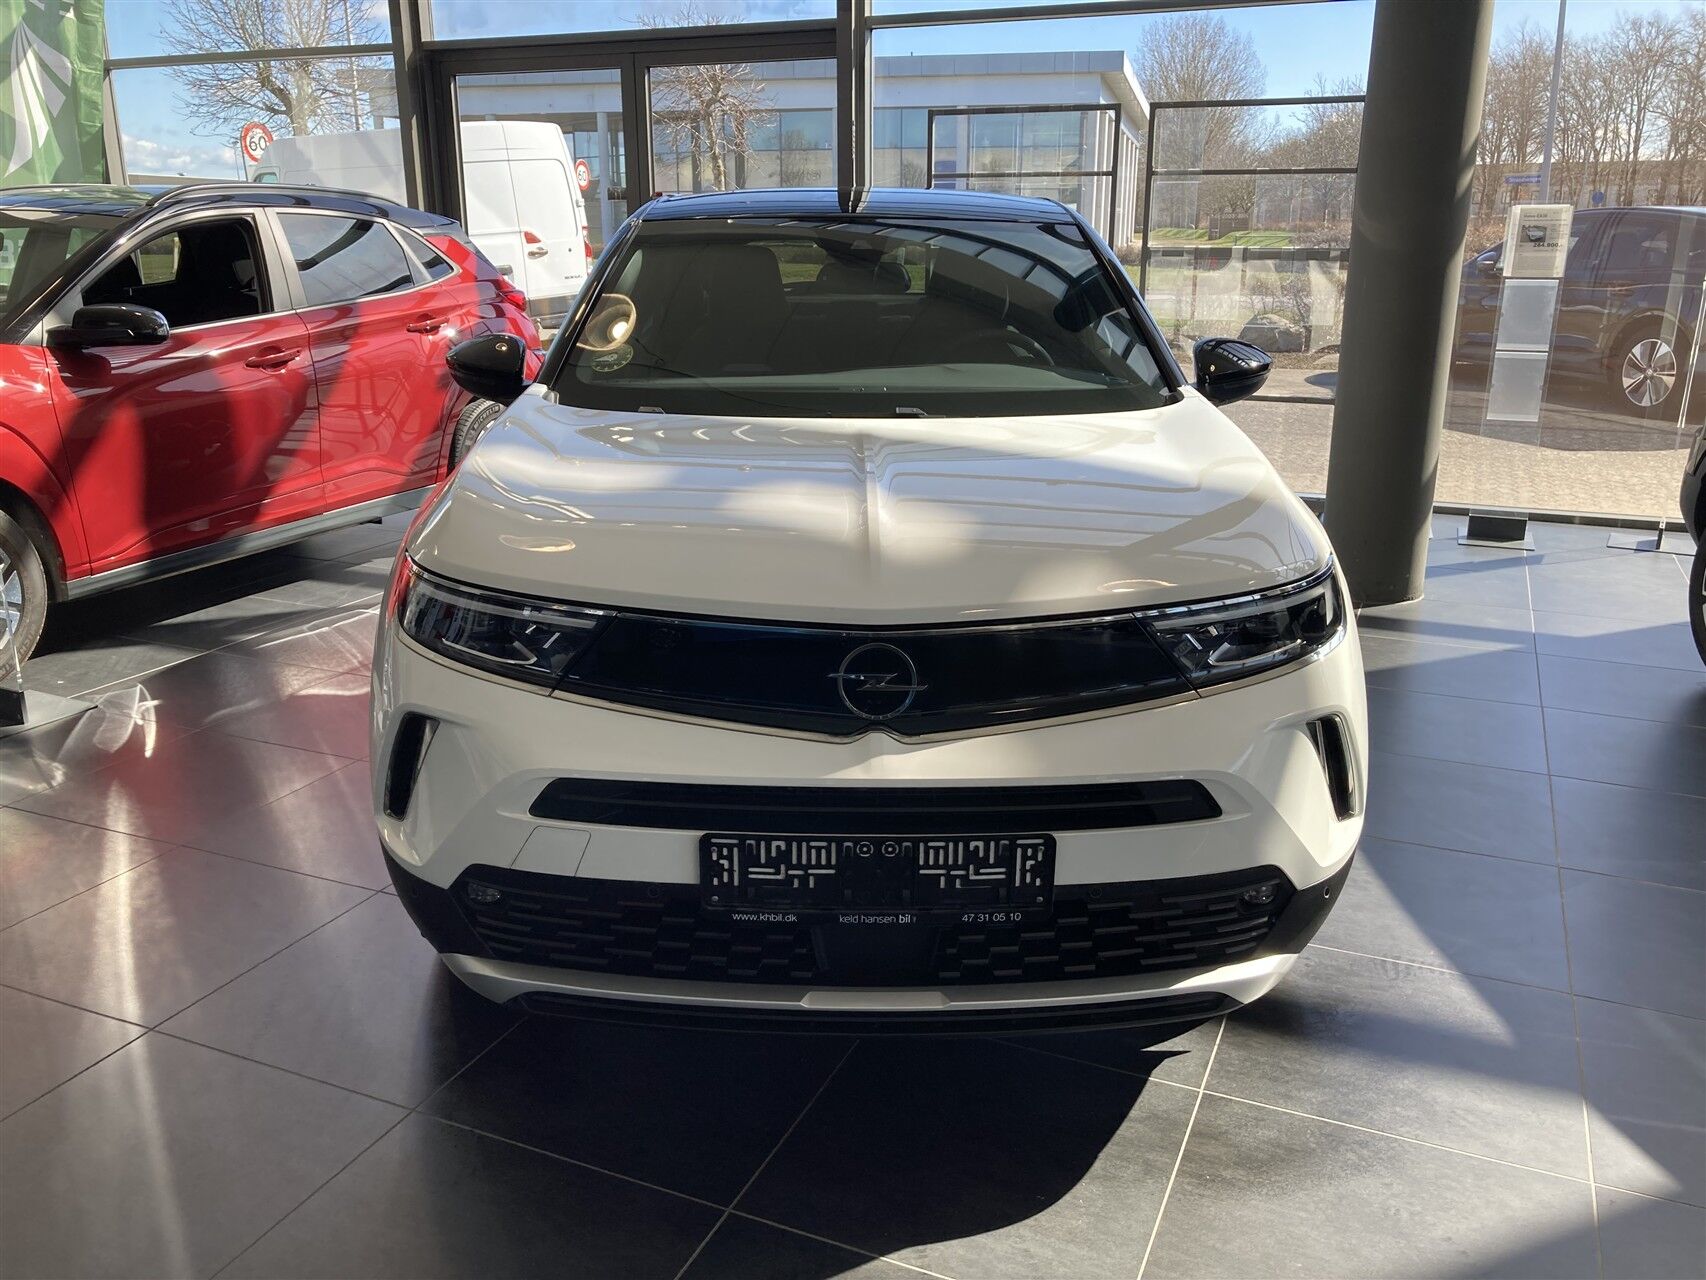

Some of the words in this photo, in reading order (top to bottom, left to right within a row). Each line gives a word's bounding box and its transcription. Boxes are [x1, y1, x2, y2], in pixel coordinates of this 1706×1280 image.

[249, 135, 267, 151] 60
[731, 912, 798, 922] www.khbil.dk
[839, 914, 859, 924] keld
[861, 914, 897, 924] hansen
[899, 913, 911, 924] bil
[961, 913, 975, 922] 47
[977, 913, 989, 922] 31
[992, 912, 1006, 922] 05
[1010, 912, 1022, 921] 10
